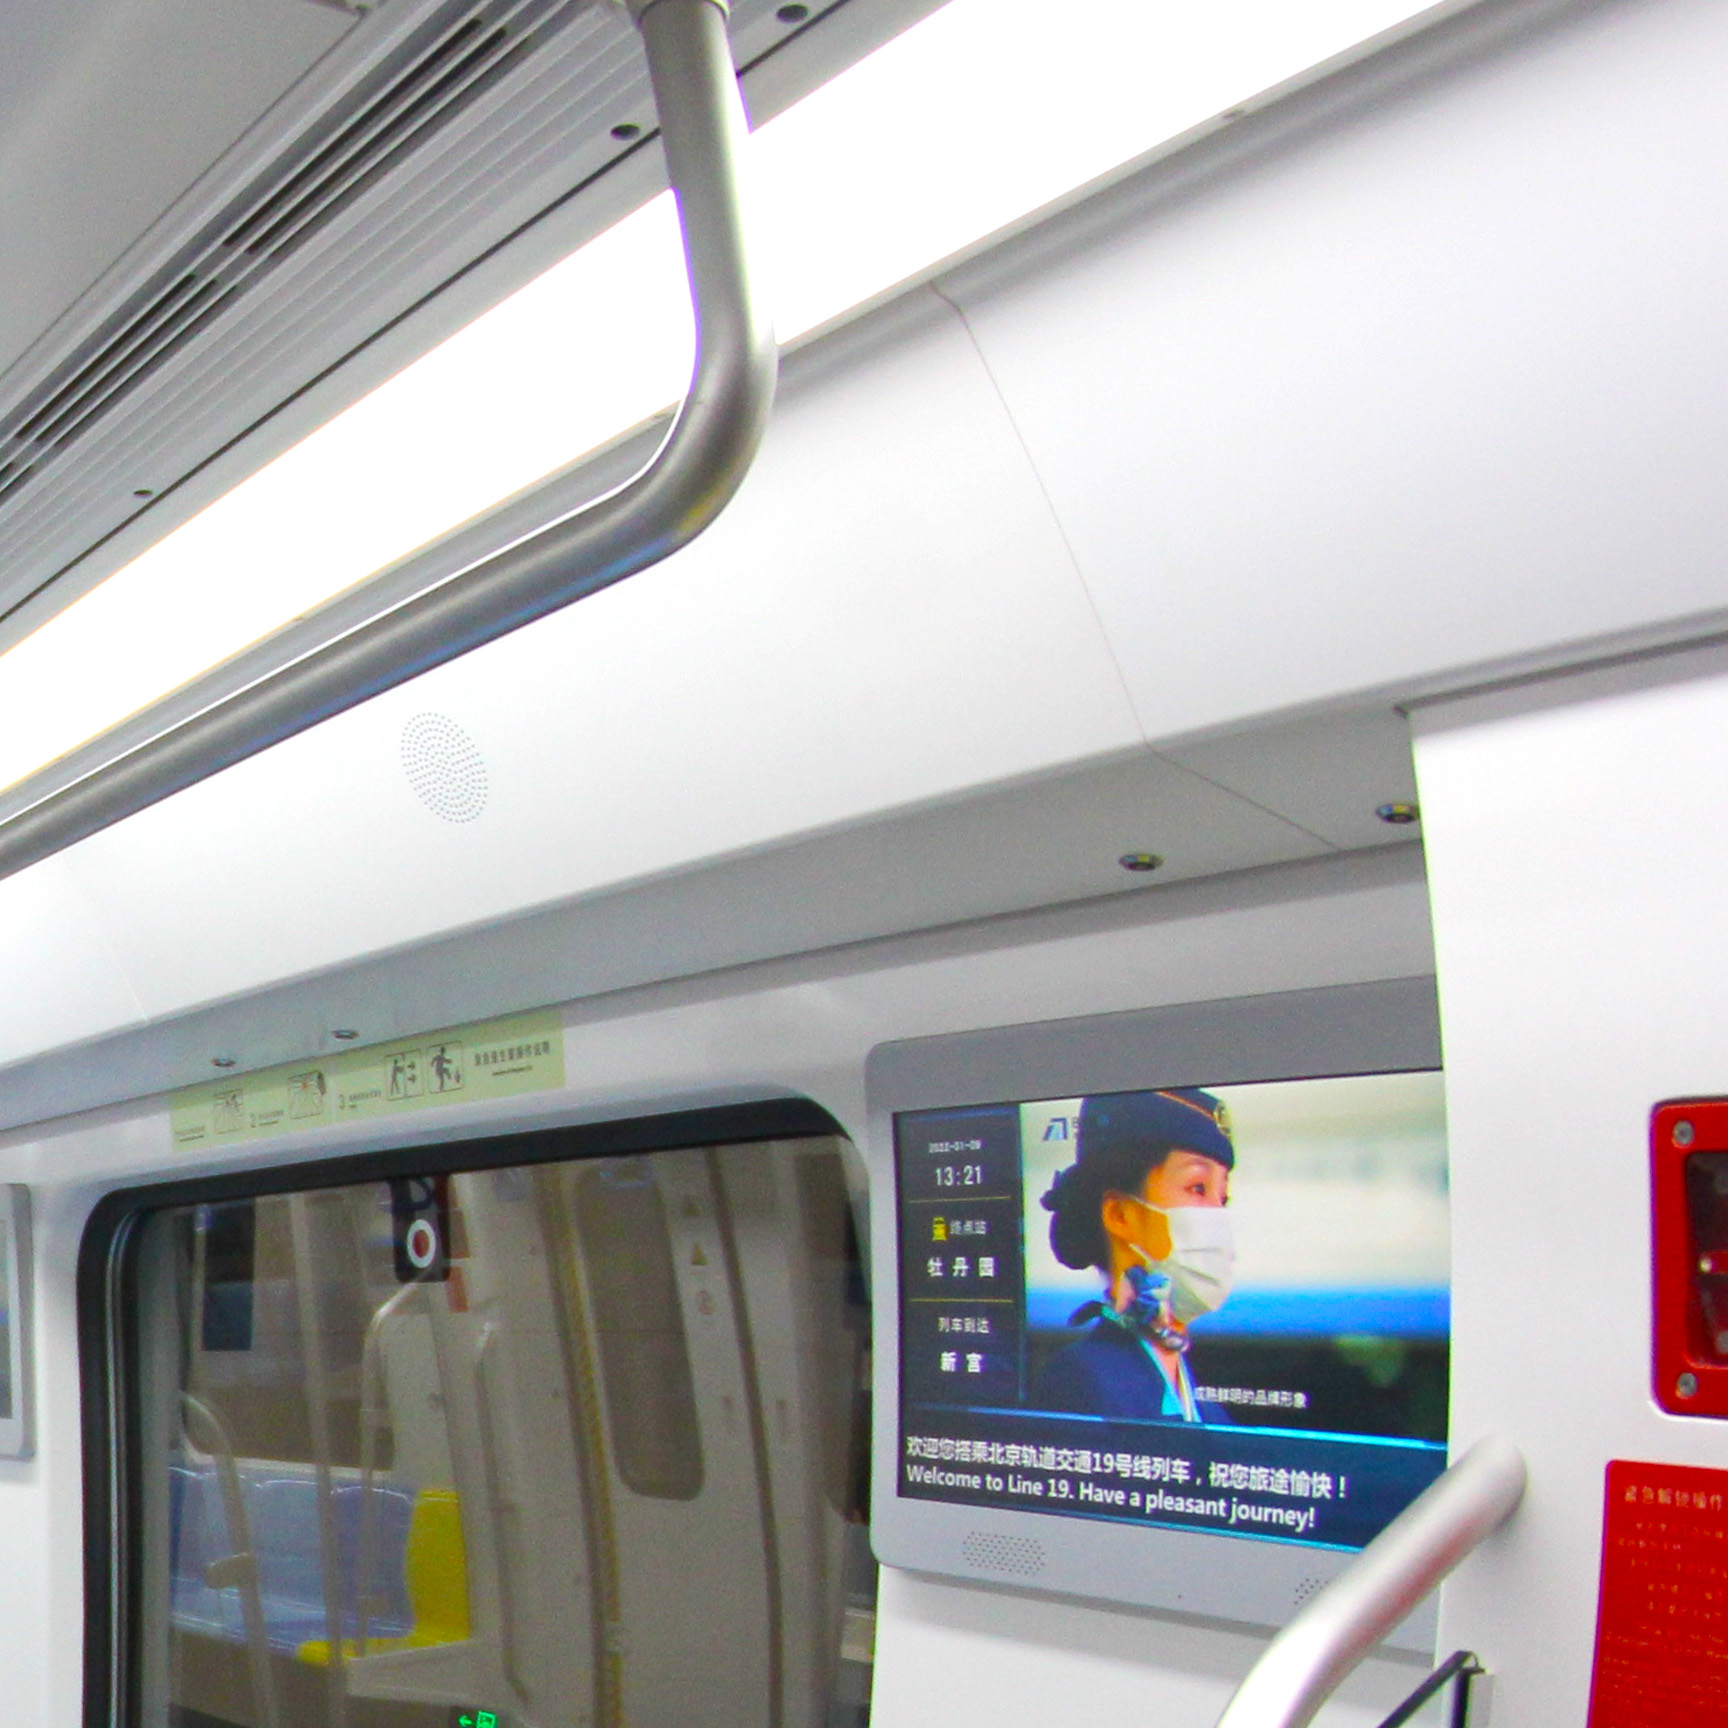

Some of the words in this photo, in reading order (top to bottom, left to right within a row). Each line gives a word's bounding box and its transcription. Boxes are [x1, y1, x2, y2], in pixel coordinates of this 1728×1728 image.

[935, 1165, 983, 1187] 13:21
[927, 1256, 994, 1278] 牡丹园
[938, 1317, 989, 1334] 列车到达
[940, 1351, 982, 1373] 新宫
[906, 1464, 981, 1489] Welcome
[985, 1474, 1003, 1492] to
[1008, 1474, 1043, 1496] Line
[1047, 1478, 1074, 1499] 19.
[1079, 1481, 1125, 1505] Have
[1129, 1491, 1141, 1506] a
[1144, 1489, 1227, 1517] pleasant
[1229, 1498, 1316, 1532] journey!
